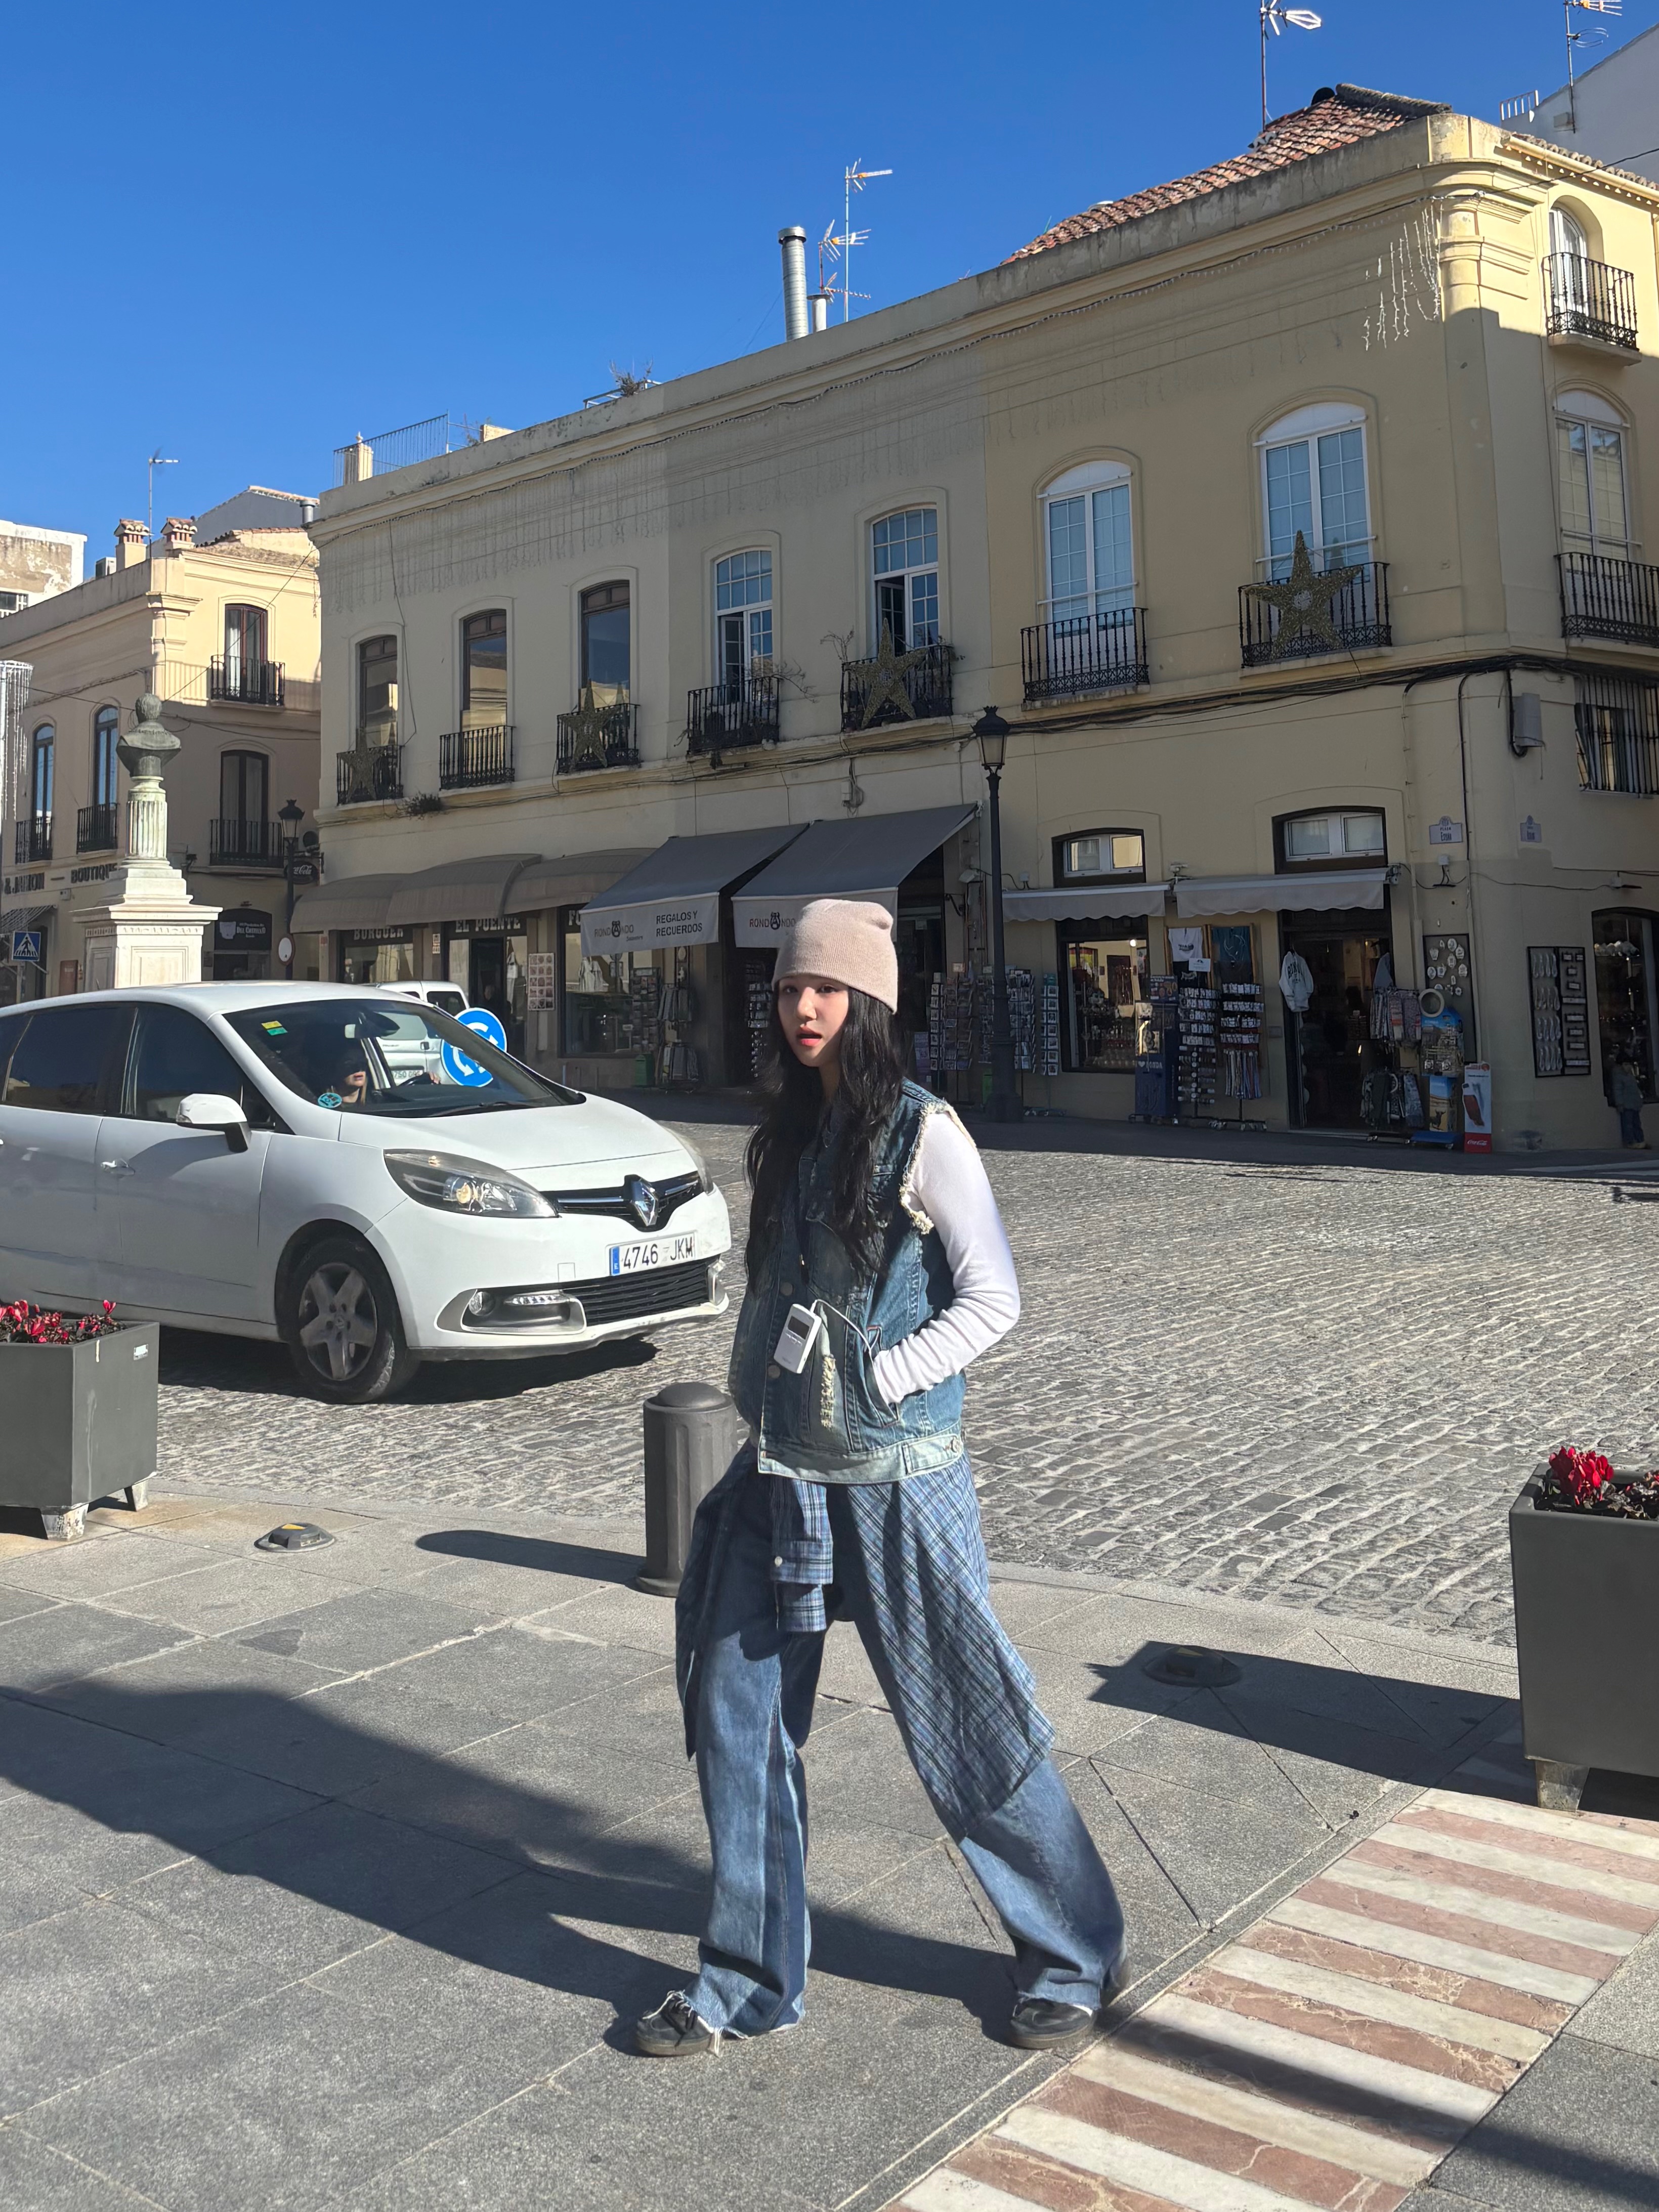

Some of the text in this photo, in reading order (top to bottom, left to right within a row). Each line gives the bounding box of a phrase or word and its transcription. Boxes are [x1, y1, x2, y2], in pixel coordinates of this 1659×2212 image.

[455, 917, 521, 932] EL PUENTE
[656, 911, 698, 924] REGALOS Y
[656, 923, 702, 937] RECUERDOS
[623, 1237, 693, 1269] 4746 JKM
